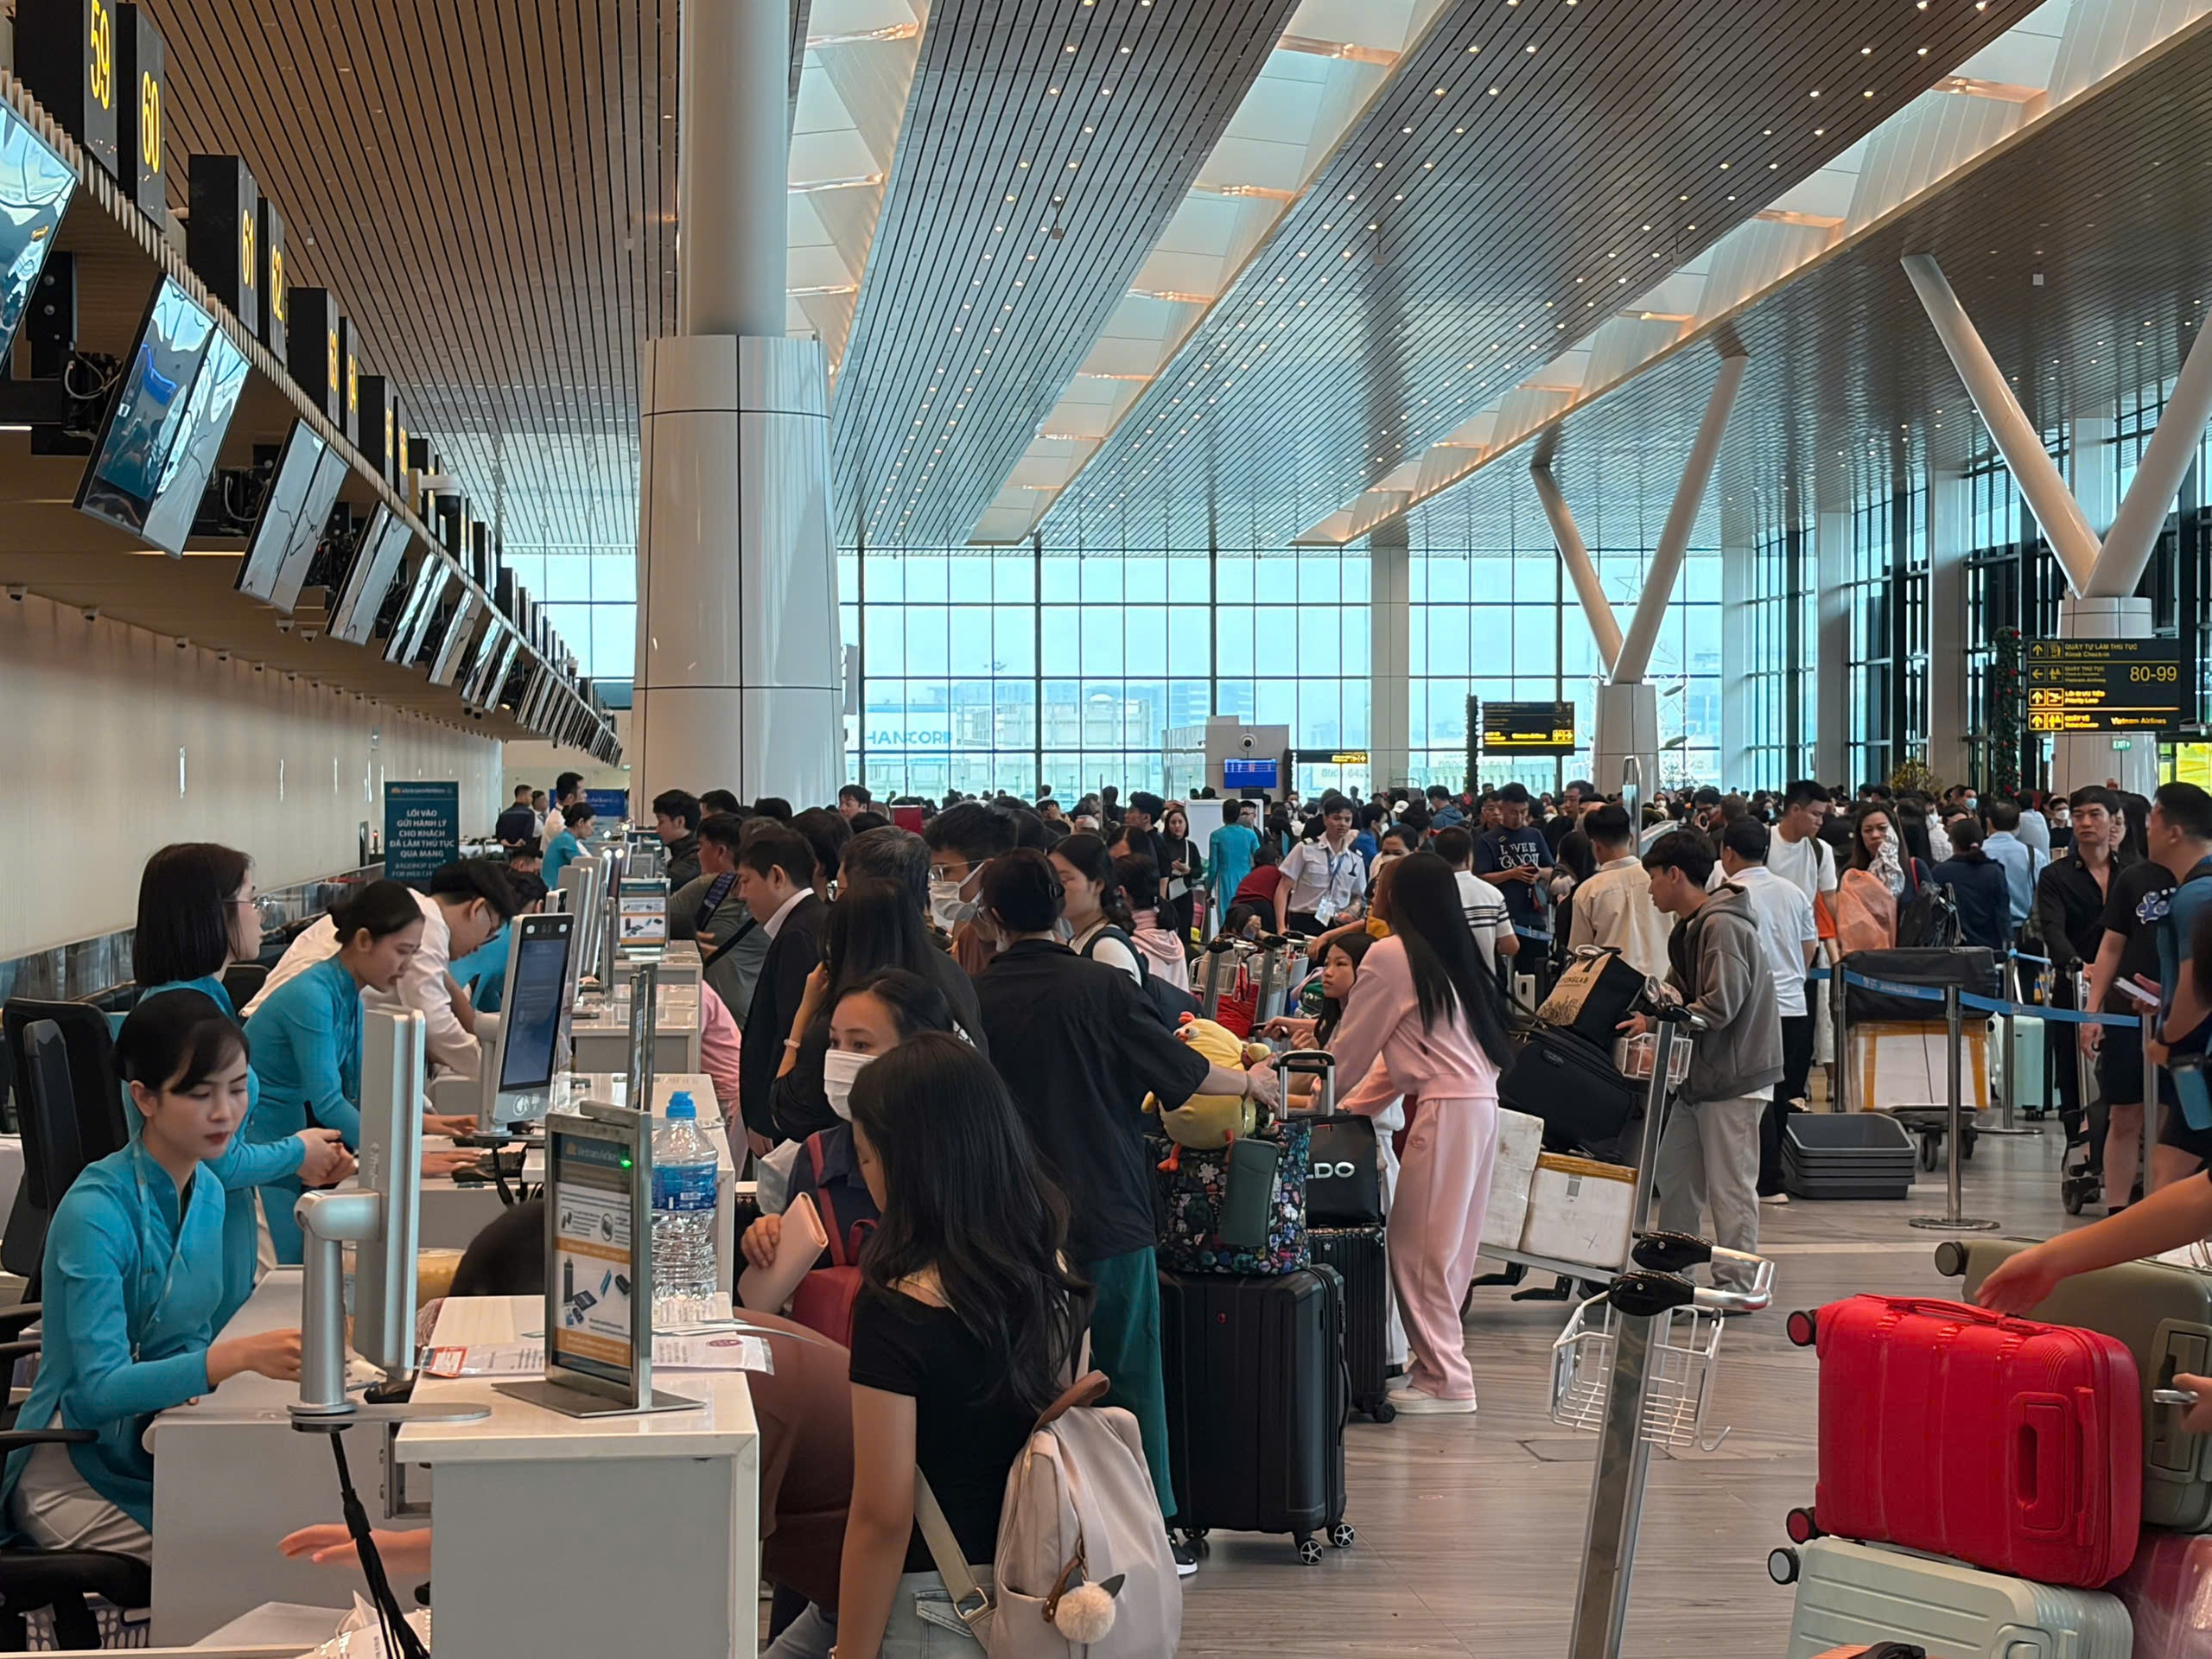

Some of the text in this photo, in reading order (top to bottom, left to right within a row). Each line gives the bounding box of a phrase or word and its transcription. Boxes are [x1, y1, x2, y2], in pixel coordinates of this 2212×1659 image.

[91, 0, 110, 110] 59
[142, 70, 160, 174] 60
[242, 208, 255, 290] 61
[271, 244, 283, 322] 62
[2129, 666, 2177, 682] 80-99
[2113, 741, 2126, 749] EXIT
[400, 849, 418, 858] QUA
[417, 829, 445, 837] KHÁCH
